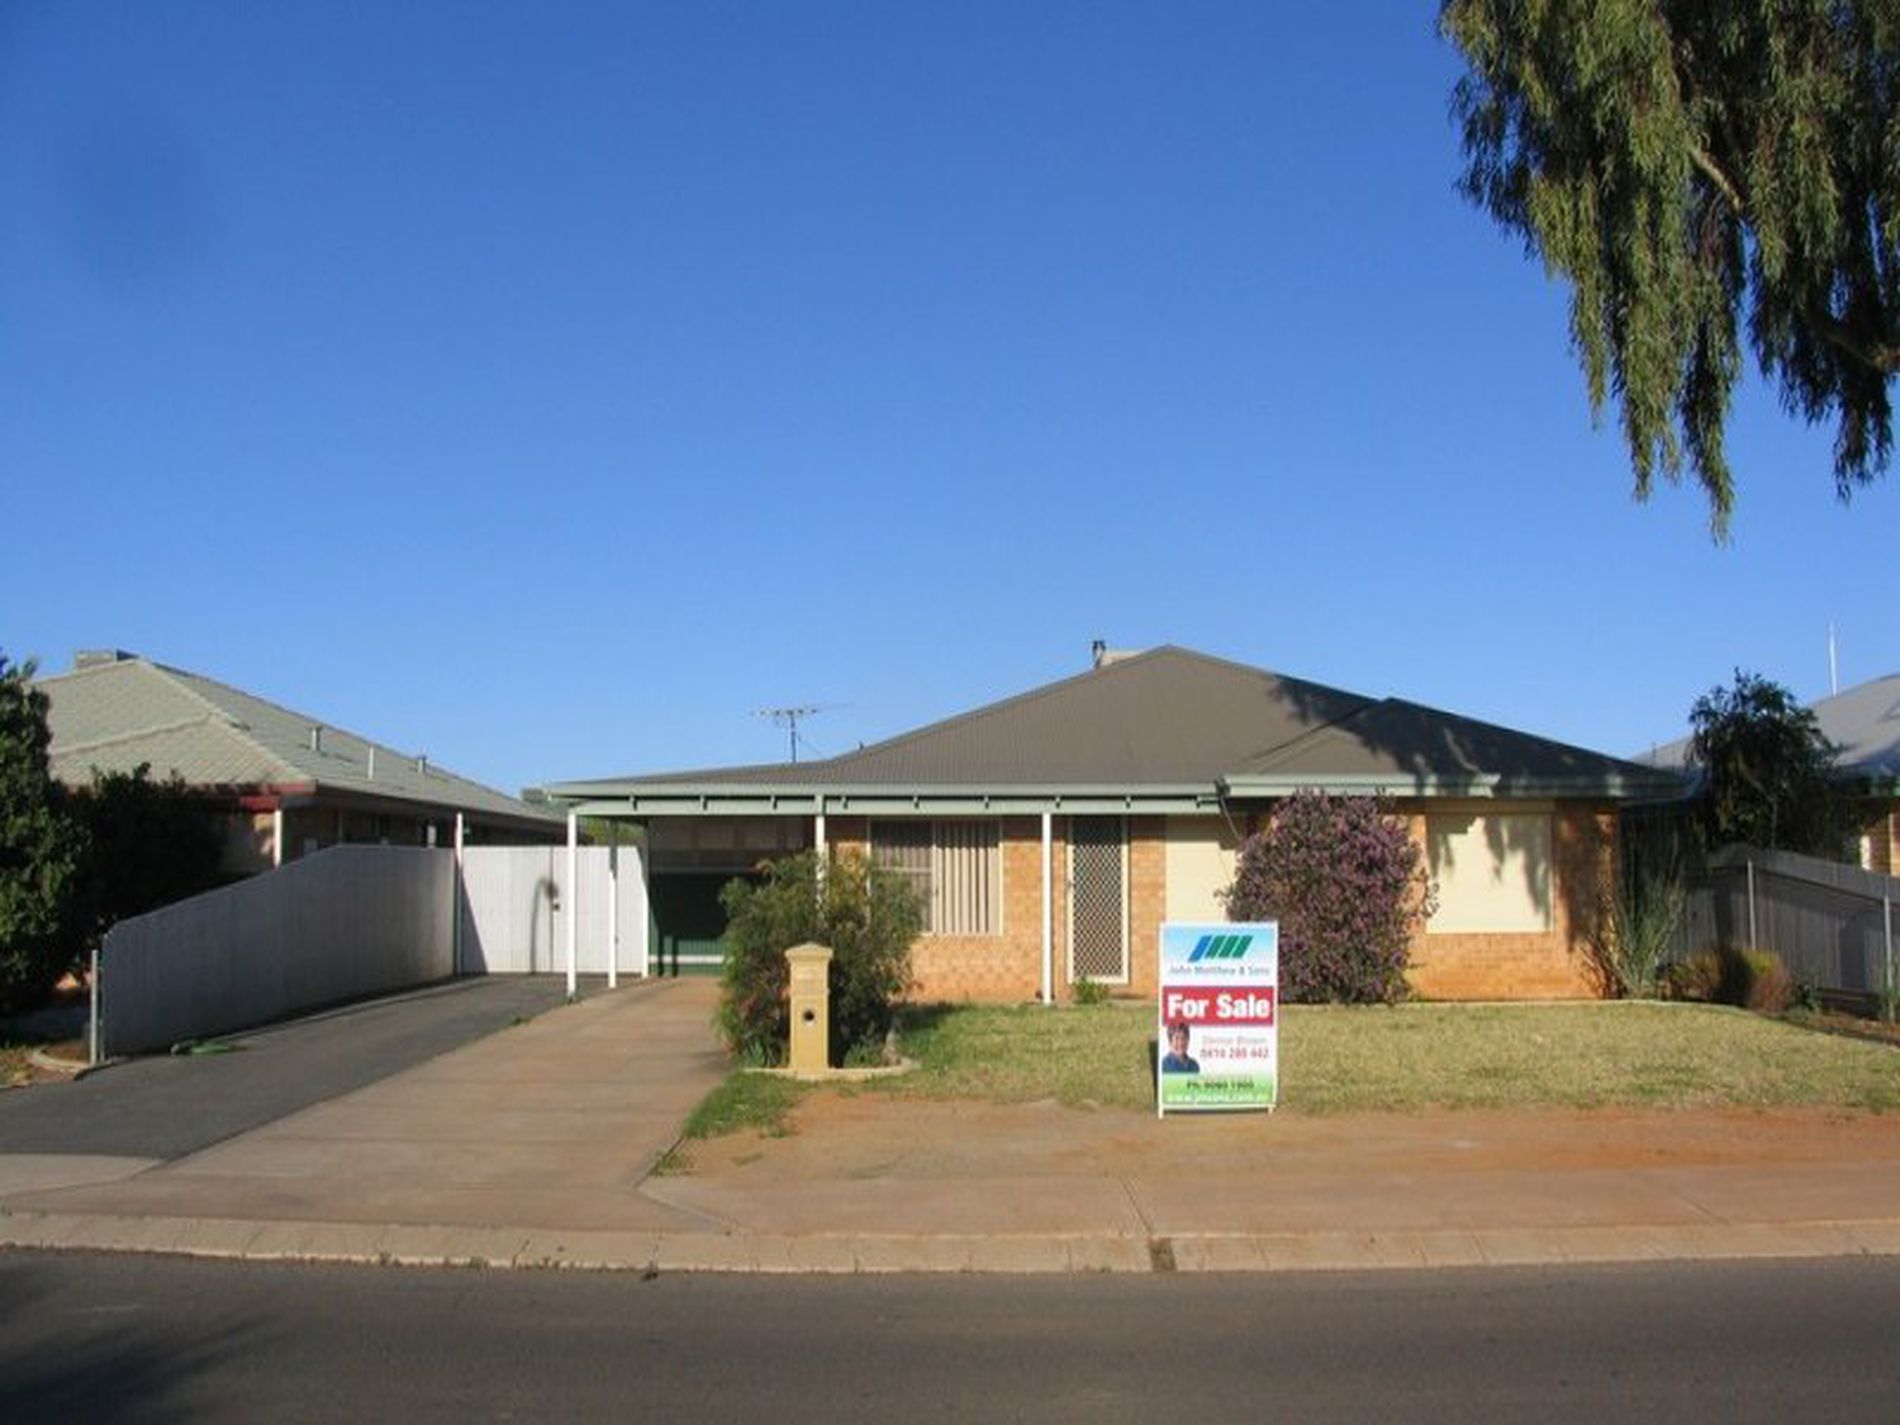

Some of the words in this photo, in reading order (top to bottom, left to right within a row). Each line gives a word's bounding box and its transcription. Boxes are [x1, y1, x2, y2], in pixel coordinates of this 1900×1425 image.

[1170, 965, 1191, 975] John
[1168, 993, 1209, 1019] For
[1216, 993, 1270, 1019] Sale
